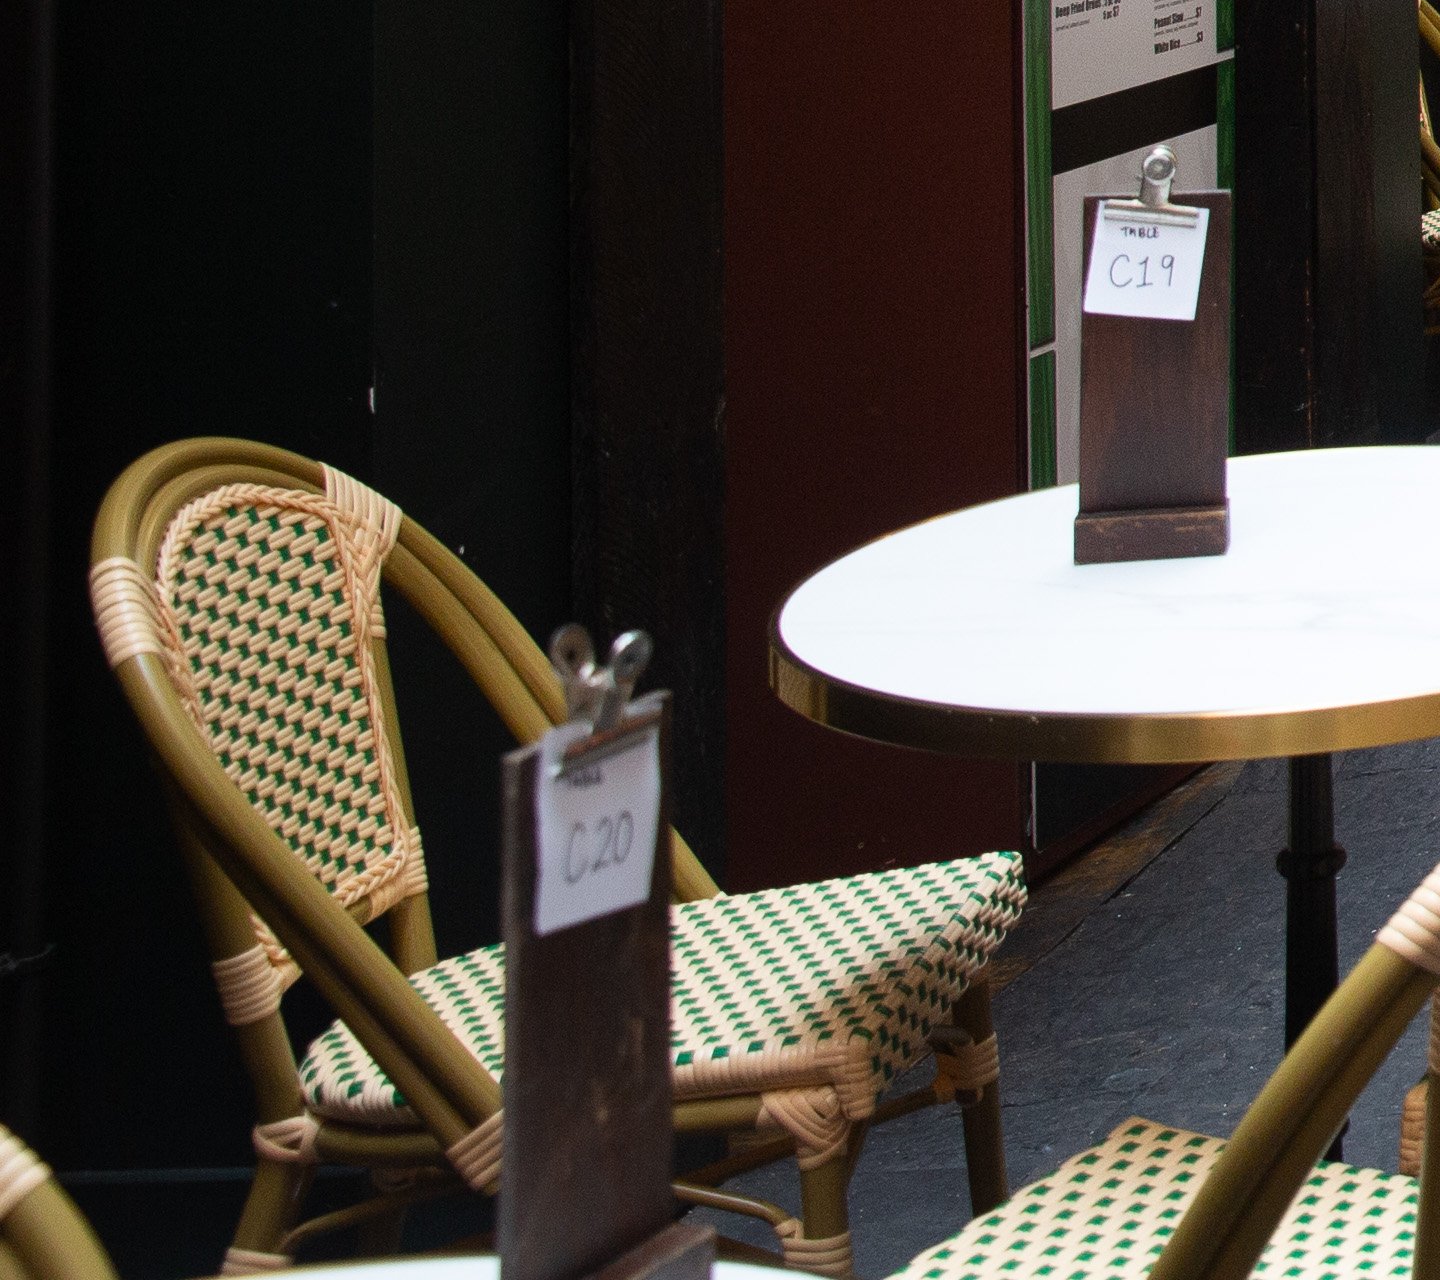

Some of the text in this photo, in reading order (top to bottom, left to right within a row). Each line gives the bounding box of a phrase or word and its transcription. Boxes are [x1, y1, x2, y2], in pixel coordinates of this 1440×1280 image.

[1170, 39, 1180, 50] Rice
[1120, 225, 1160, 240] TABLE
[1108, 253, 1175, 290] C19
[562, 811, 634, 885] C20
